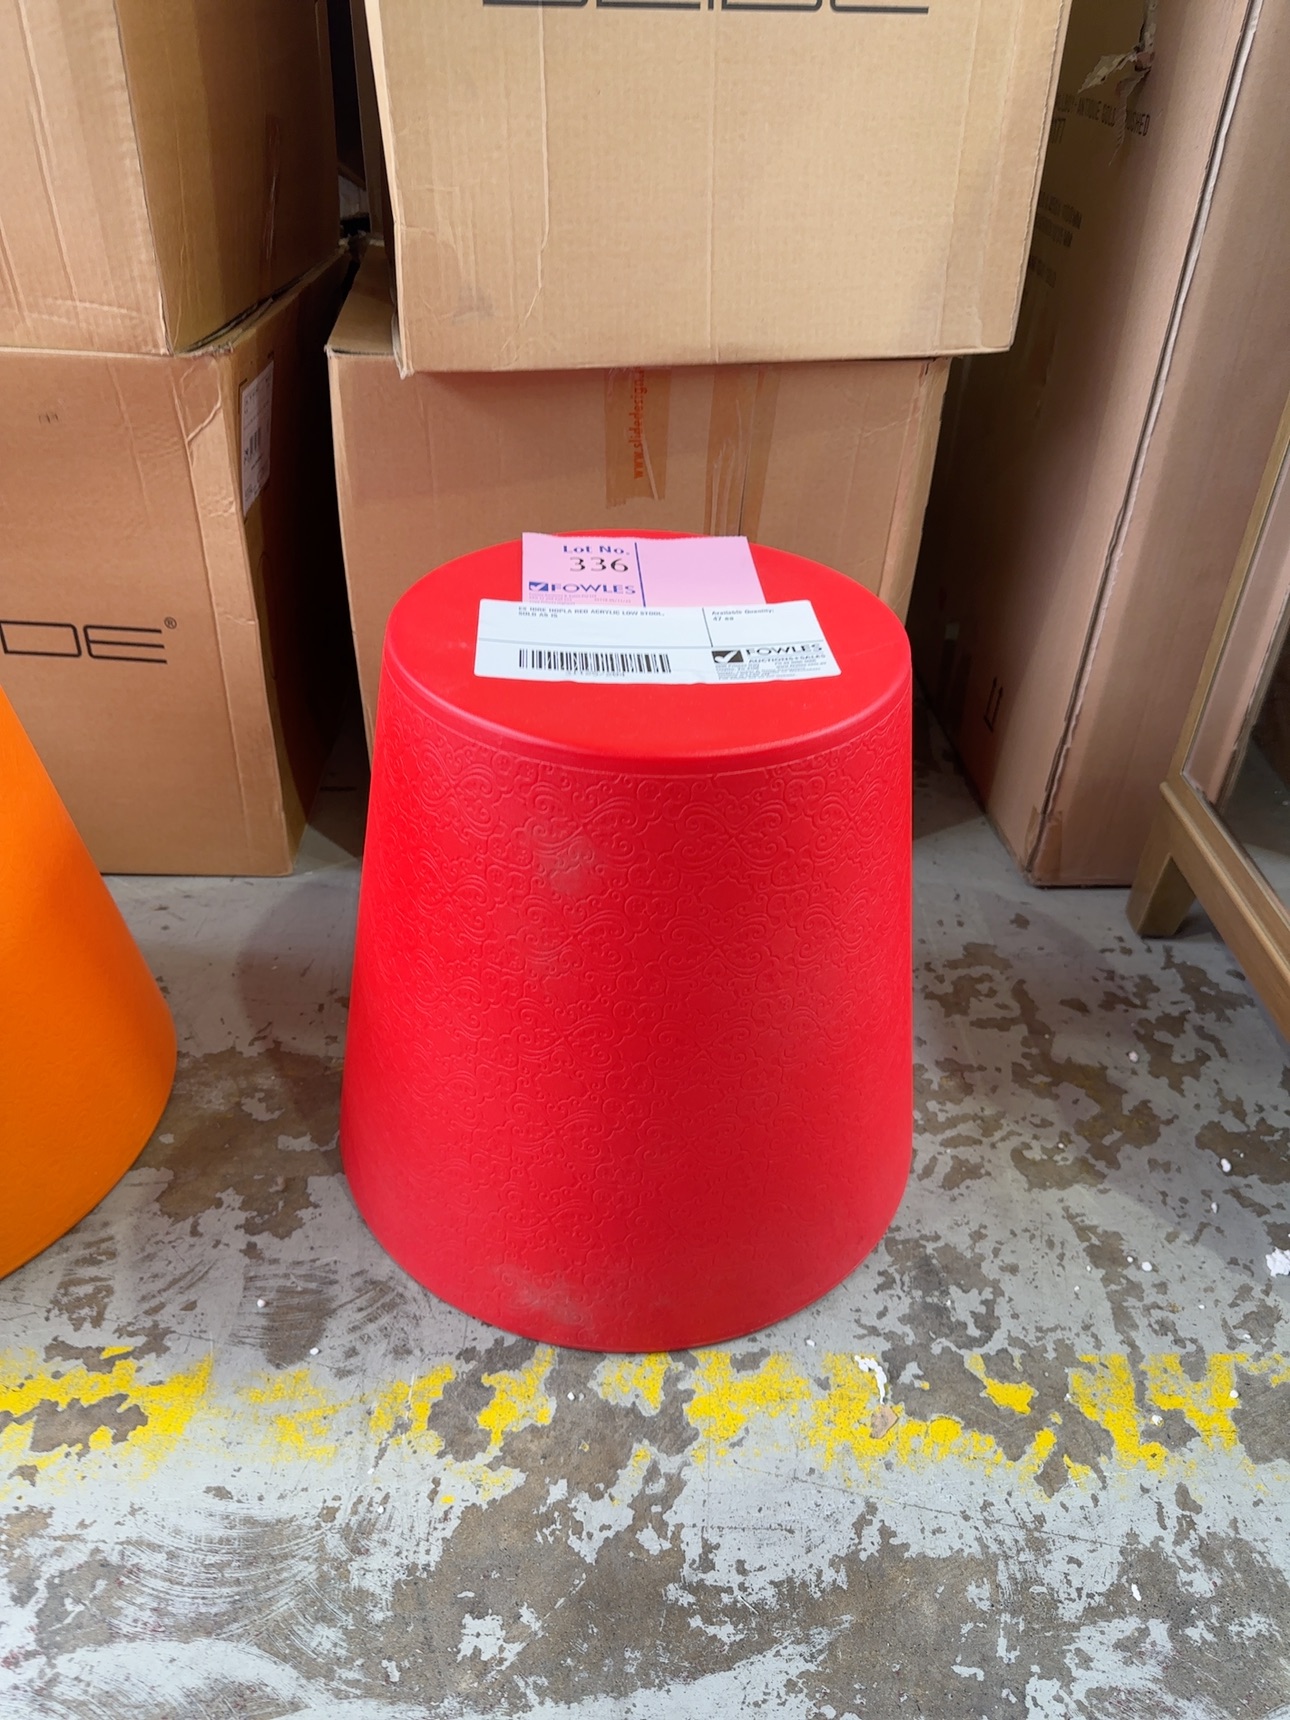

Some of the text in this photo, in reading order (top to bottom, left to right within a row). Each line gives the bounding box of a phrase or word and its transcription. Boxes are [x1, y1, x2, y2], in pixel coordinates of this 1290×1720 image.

[563, 545, 630, 556] Lot No.
[569, 557, 629, 573] 336
[551, 583, 637, 595] FOWLES
[745, 643, 823, 656] FOWLES
